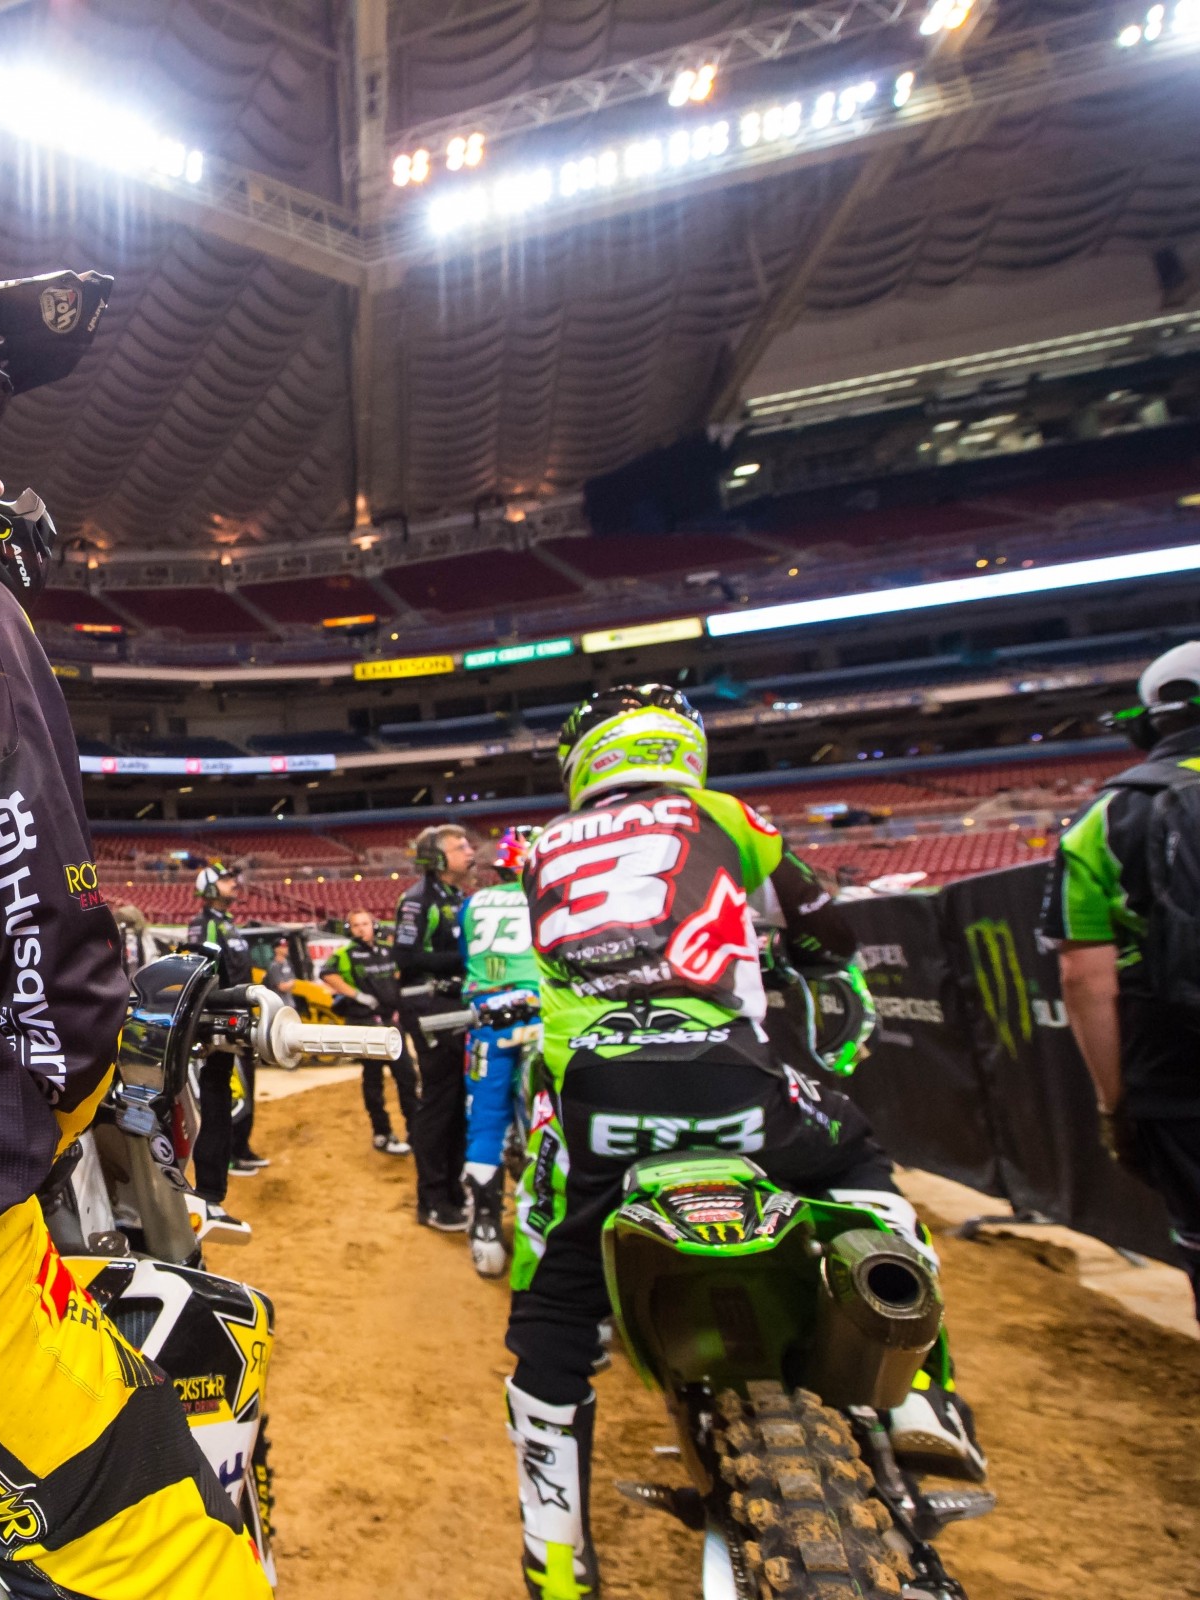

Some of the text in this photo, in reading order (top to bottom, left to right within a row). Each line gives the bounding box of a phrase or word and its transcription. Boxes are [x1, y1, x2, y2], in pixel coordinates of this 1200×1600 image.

[11, 543, 31, 588] Airoh
[361, 660, 448, 678] EMERSON
[627, 737, 680, 765] 3
[65, 863, 97, 894] RO
[536, 833, 684, 950] 3
[80, 889, 104, 908] EN
[468, 906, 533, 957] 33
[590, 1106, 766, 1157] ET3
